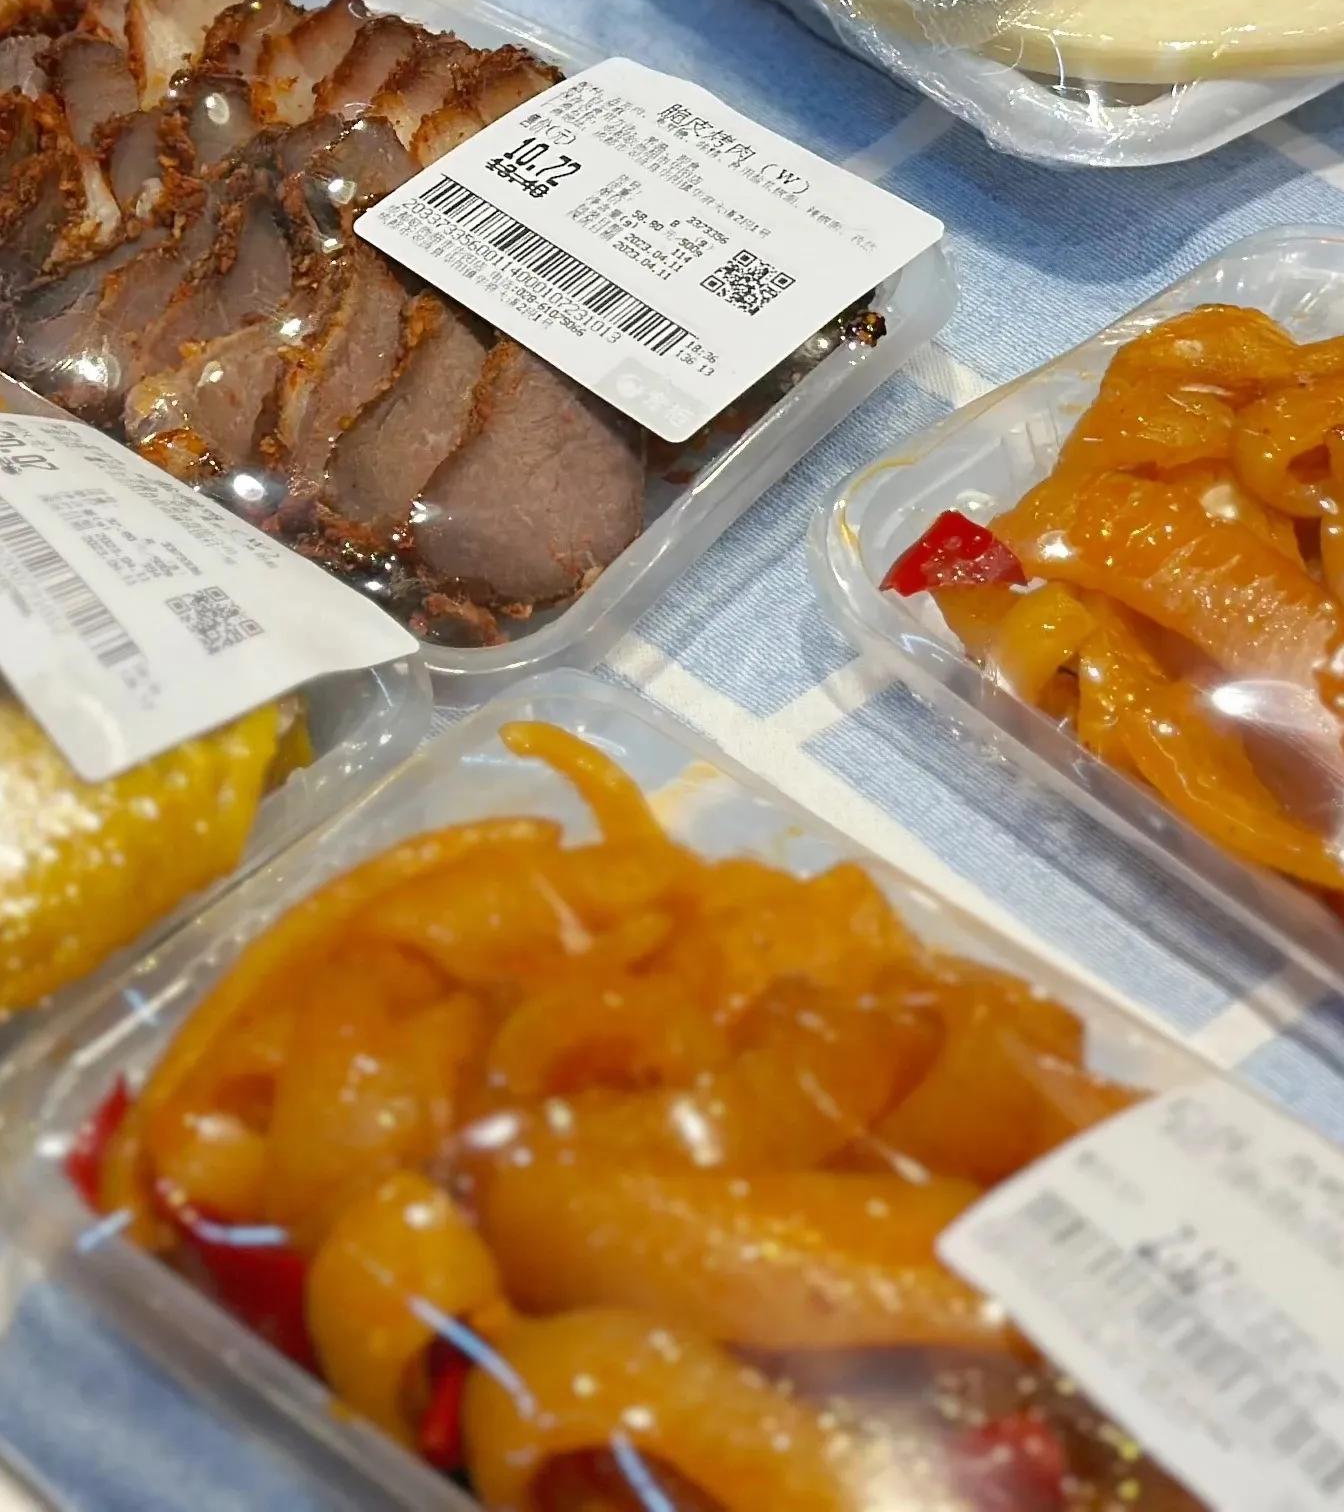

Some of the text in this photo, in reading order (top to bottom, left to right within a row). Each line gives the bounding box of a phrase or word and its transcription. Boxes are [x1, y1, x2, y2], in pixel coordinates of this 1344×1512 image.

[500, 135, 585, 187] 10.72
[629, 209, 666, 232] 58.80
[684, 215, 731, 245] 3373356
[611, 240, 672, 280] 2023.04.11
[623, 232, 684, 272] 2023.04.11
[670, 248, 694, 263] 114
[682, 339, 720, 364] 18:36
[695, 363, 717, 378] 13
